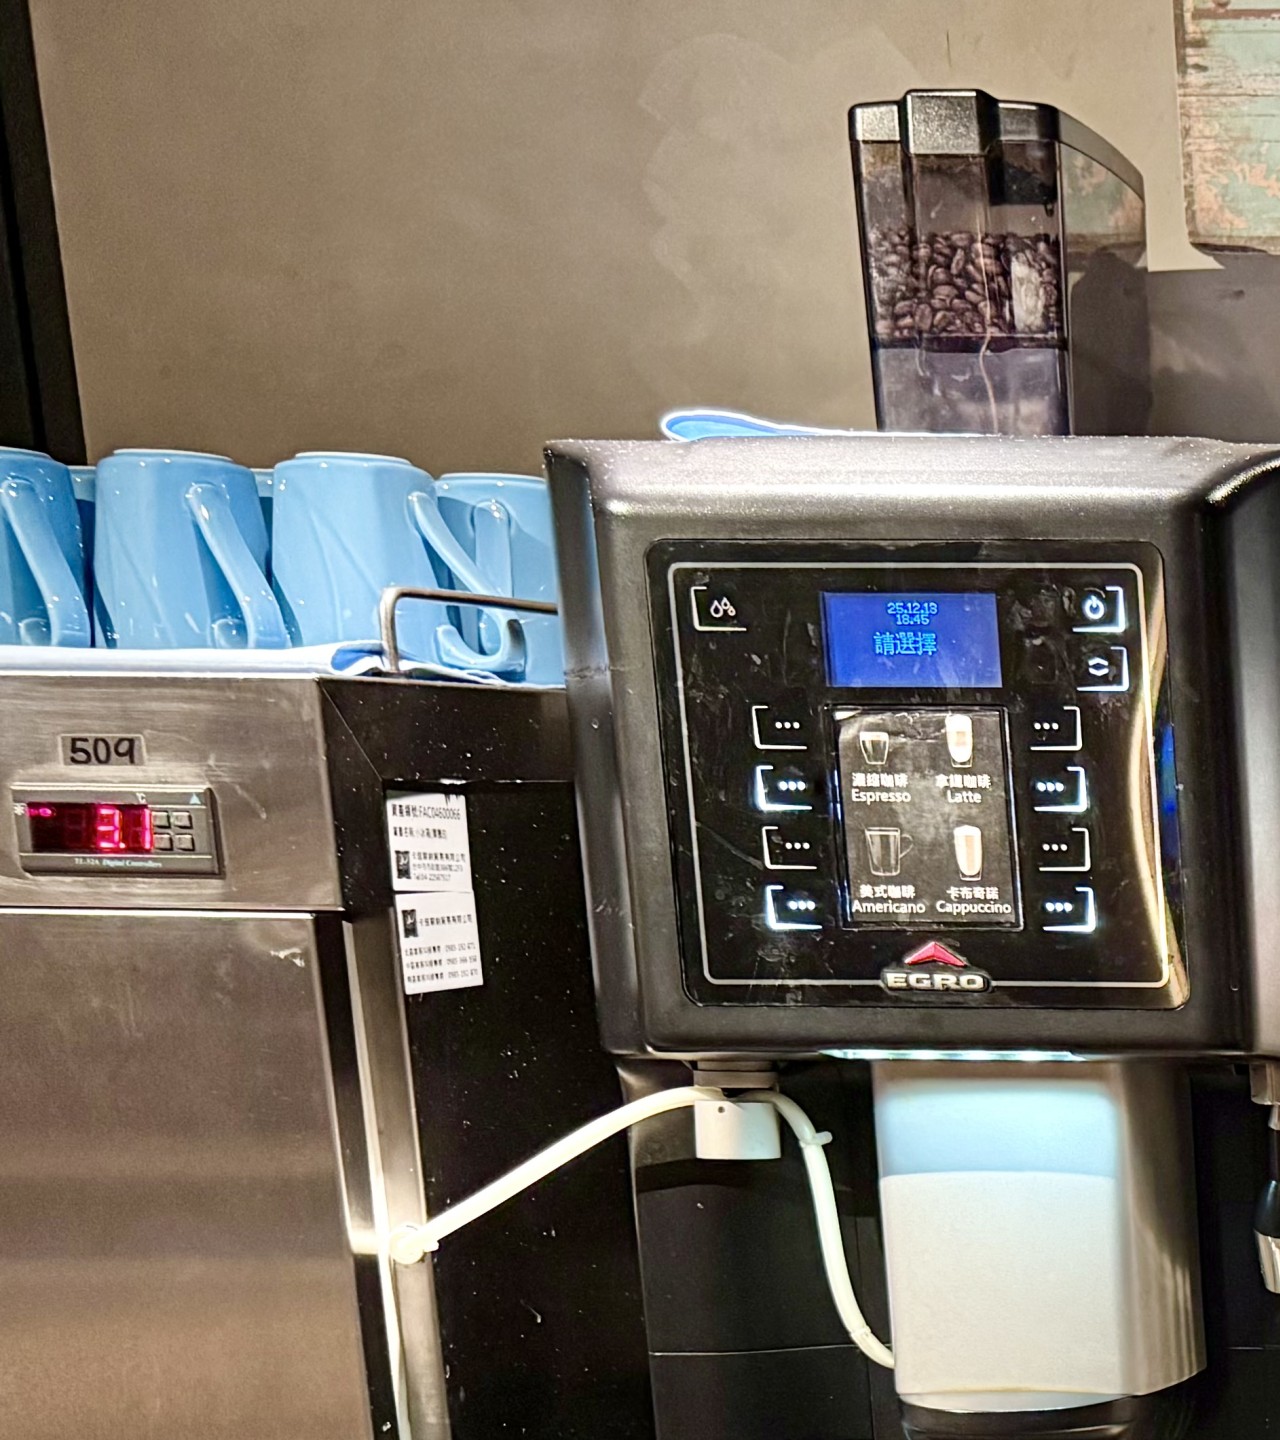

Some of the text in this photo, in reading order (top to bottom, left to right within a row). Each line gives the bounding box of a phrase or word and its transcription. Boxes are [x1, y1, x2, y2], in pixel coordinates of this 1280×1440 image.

[873, 631, 938, 656] 請選擇
[69, 737, 136, 765] 509
[851, 788, 911, 805] Espresso
[947, 790, 982, 803] Latte
[851, 900, 926, 914] Americano
[936, 900, 1012, 916] Cappuccino
[886, 971, 985, 991] EGRO
